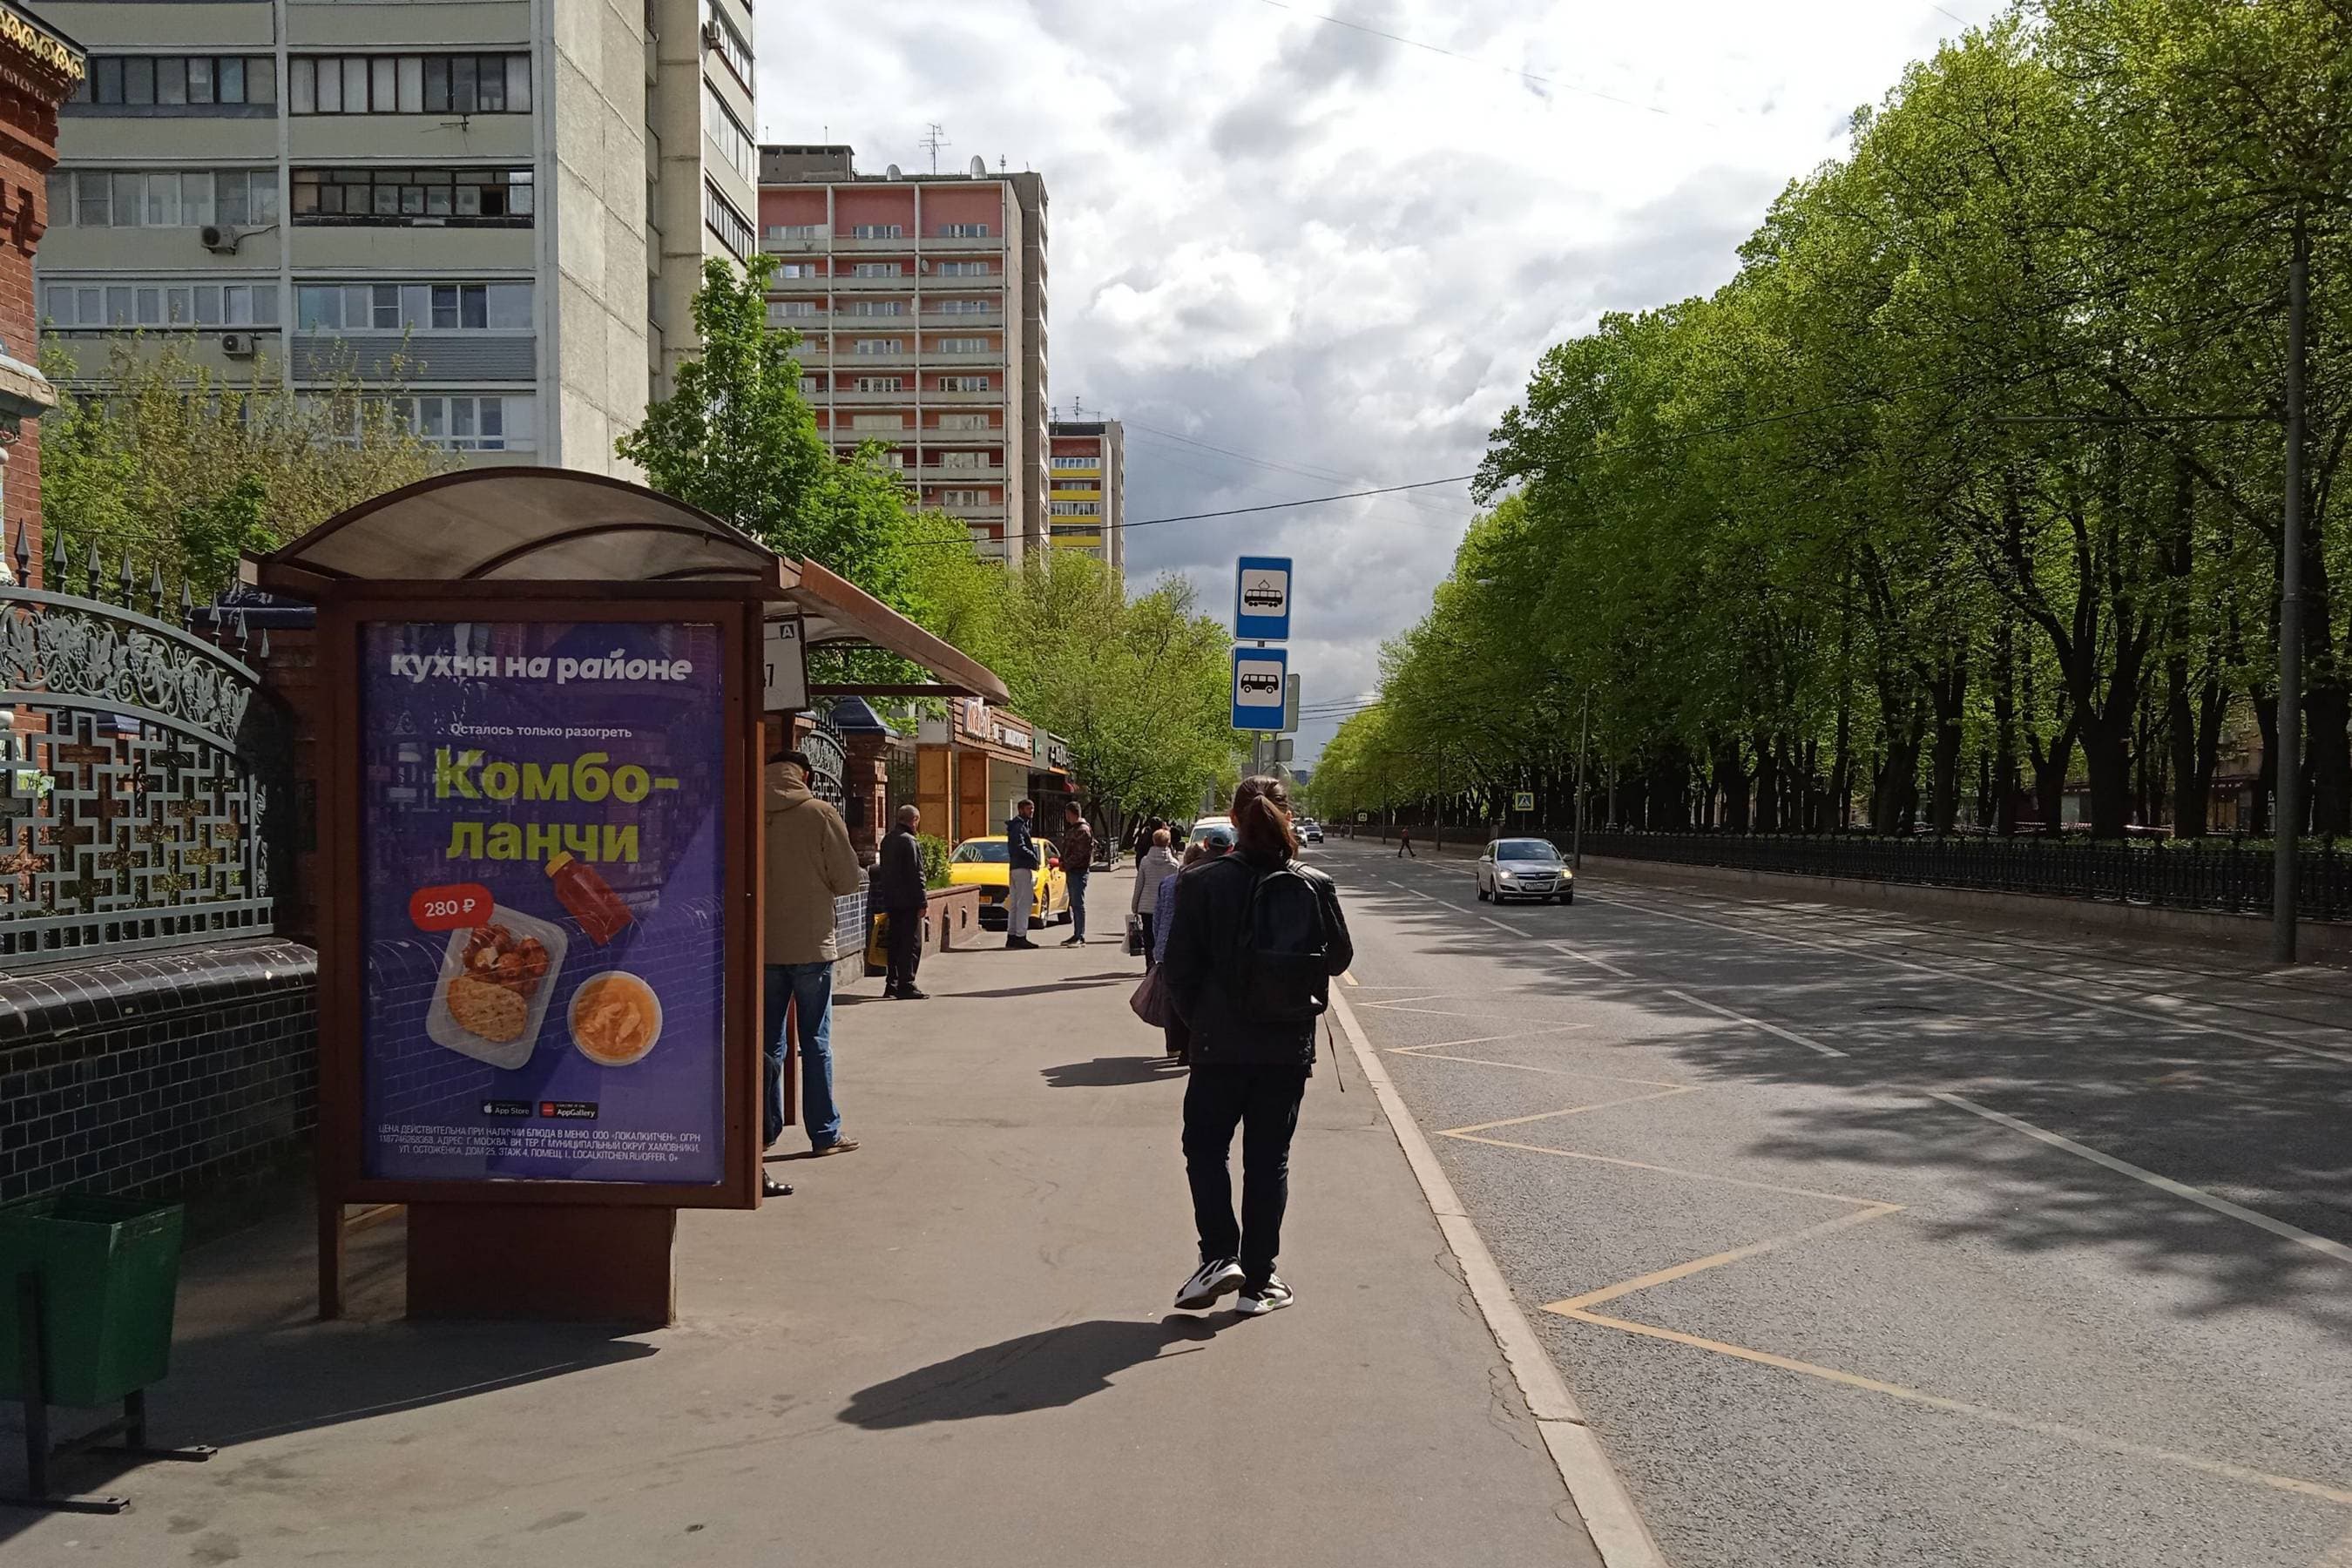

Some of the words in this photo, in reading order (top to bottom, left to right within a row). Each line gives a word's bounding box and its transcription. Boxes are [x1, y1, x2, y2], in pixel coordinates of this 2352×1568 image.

[390, 653, 497, 683] кухня
[505, 655, 549, 679] на
[558, 648, 693, 684] районе
[450, 724, 514, 737] Осталось
[517, 725, 563, 737] только
[565, 727, 632, 740] разогреть
[435, 748, 679, 803] Комбо-
[446, 821, 639, 863] ланчи
[424, 901, 457, 917] 280
[557, 1109, 596, 1119] AppGallery
[378, 1124, 399, 1133] ЦЕНА
[401, 1125, 466, 1135] ДЕЙСТВИТЕЛЬНА
[468, 1126, 484, 1135] ПРИ
[486, 1127, 524, 1137] НАЛИЧИИ
[526, 1128, 556, 1139] БЛЮДА
[558, 1129, 563, 1138] В
[592, 1131, 609, 1139] ООО
[680, 1132, 701, 1142] ОГРН
[465, 1146, 484, 1155] ДОМ
[498, 1148, 521, 1157] ЭТАЖ
[548, 1139, 620, 1150] МУНИЦИПАЛЬНЫЙ
[622, 1141, 646, 1151] ОКРУГ
